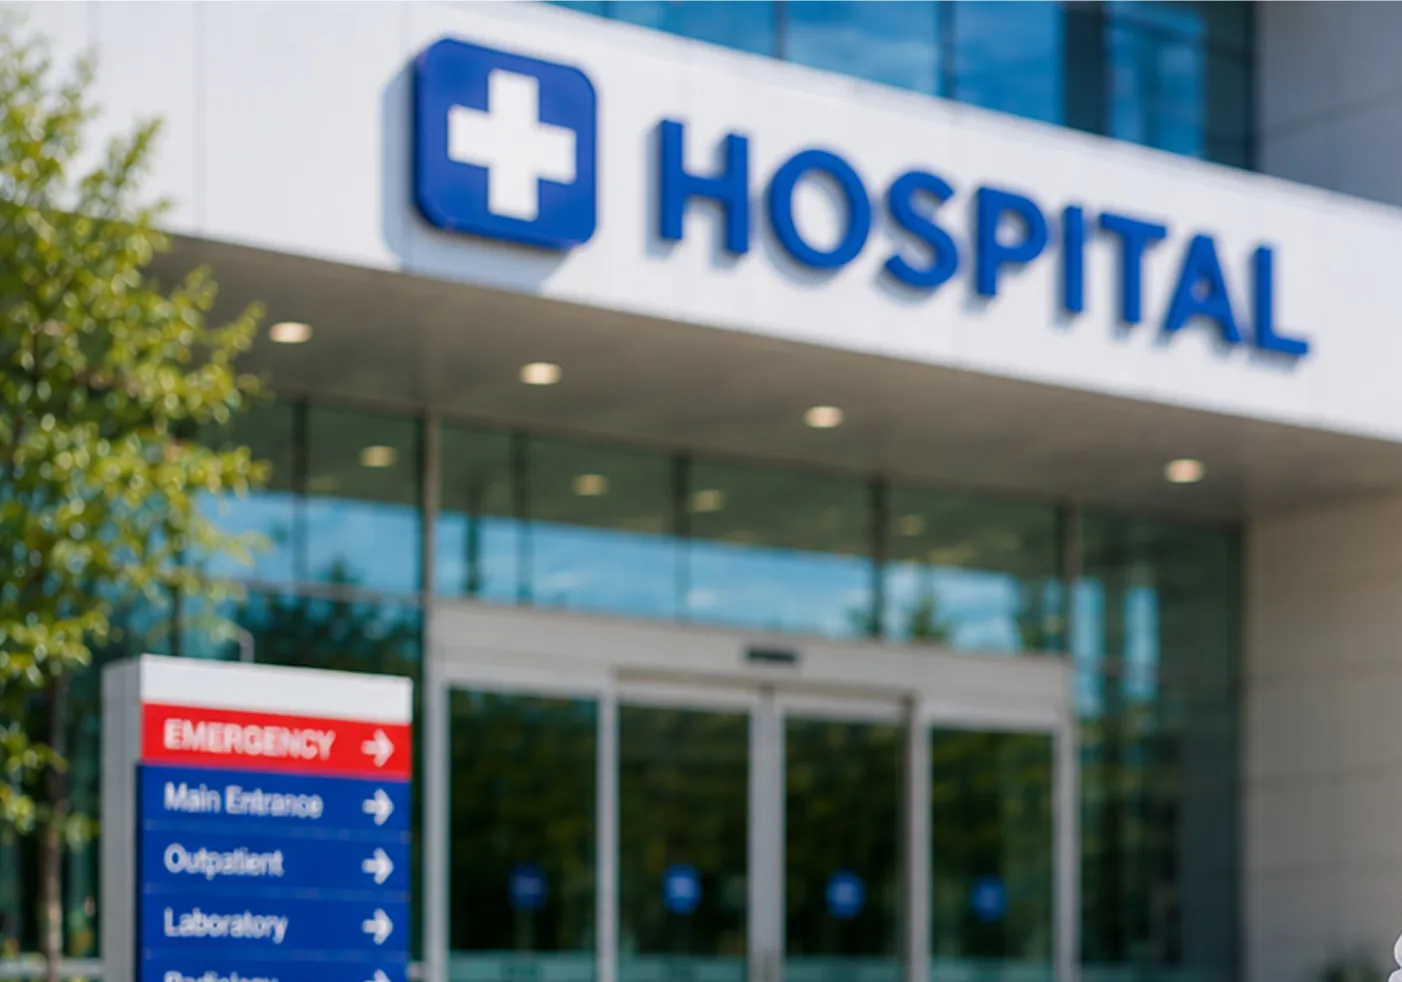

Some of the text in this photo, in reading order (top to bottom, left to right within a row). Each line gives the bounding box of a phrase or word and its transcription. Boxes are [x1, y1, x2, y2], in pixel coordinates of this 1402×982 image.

[656, 117, 1311, 358] HOSPITAL
[163, 718, 337, 761] EMERGENCY
[164, 781, 325, 820] Main Entrance
[164, 843, 285, 881] Outpatient
[164, 907, 289, 944] Laboratory
